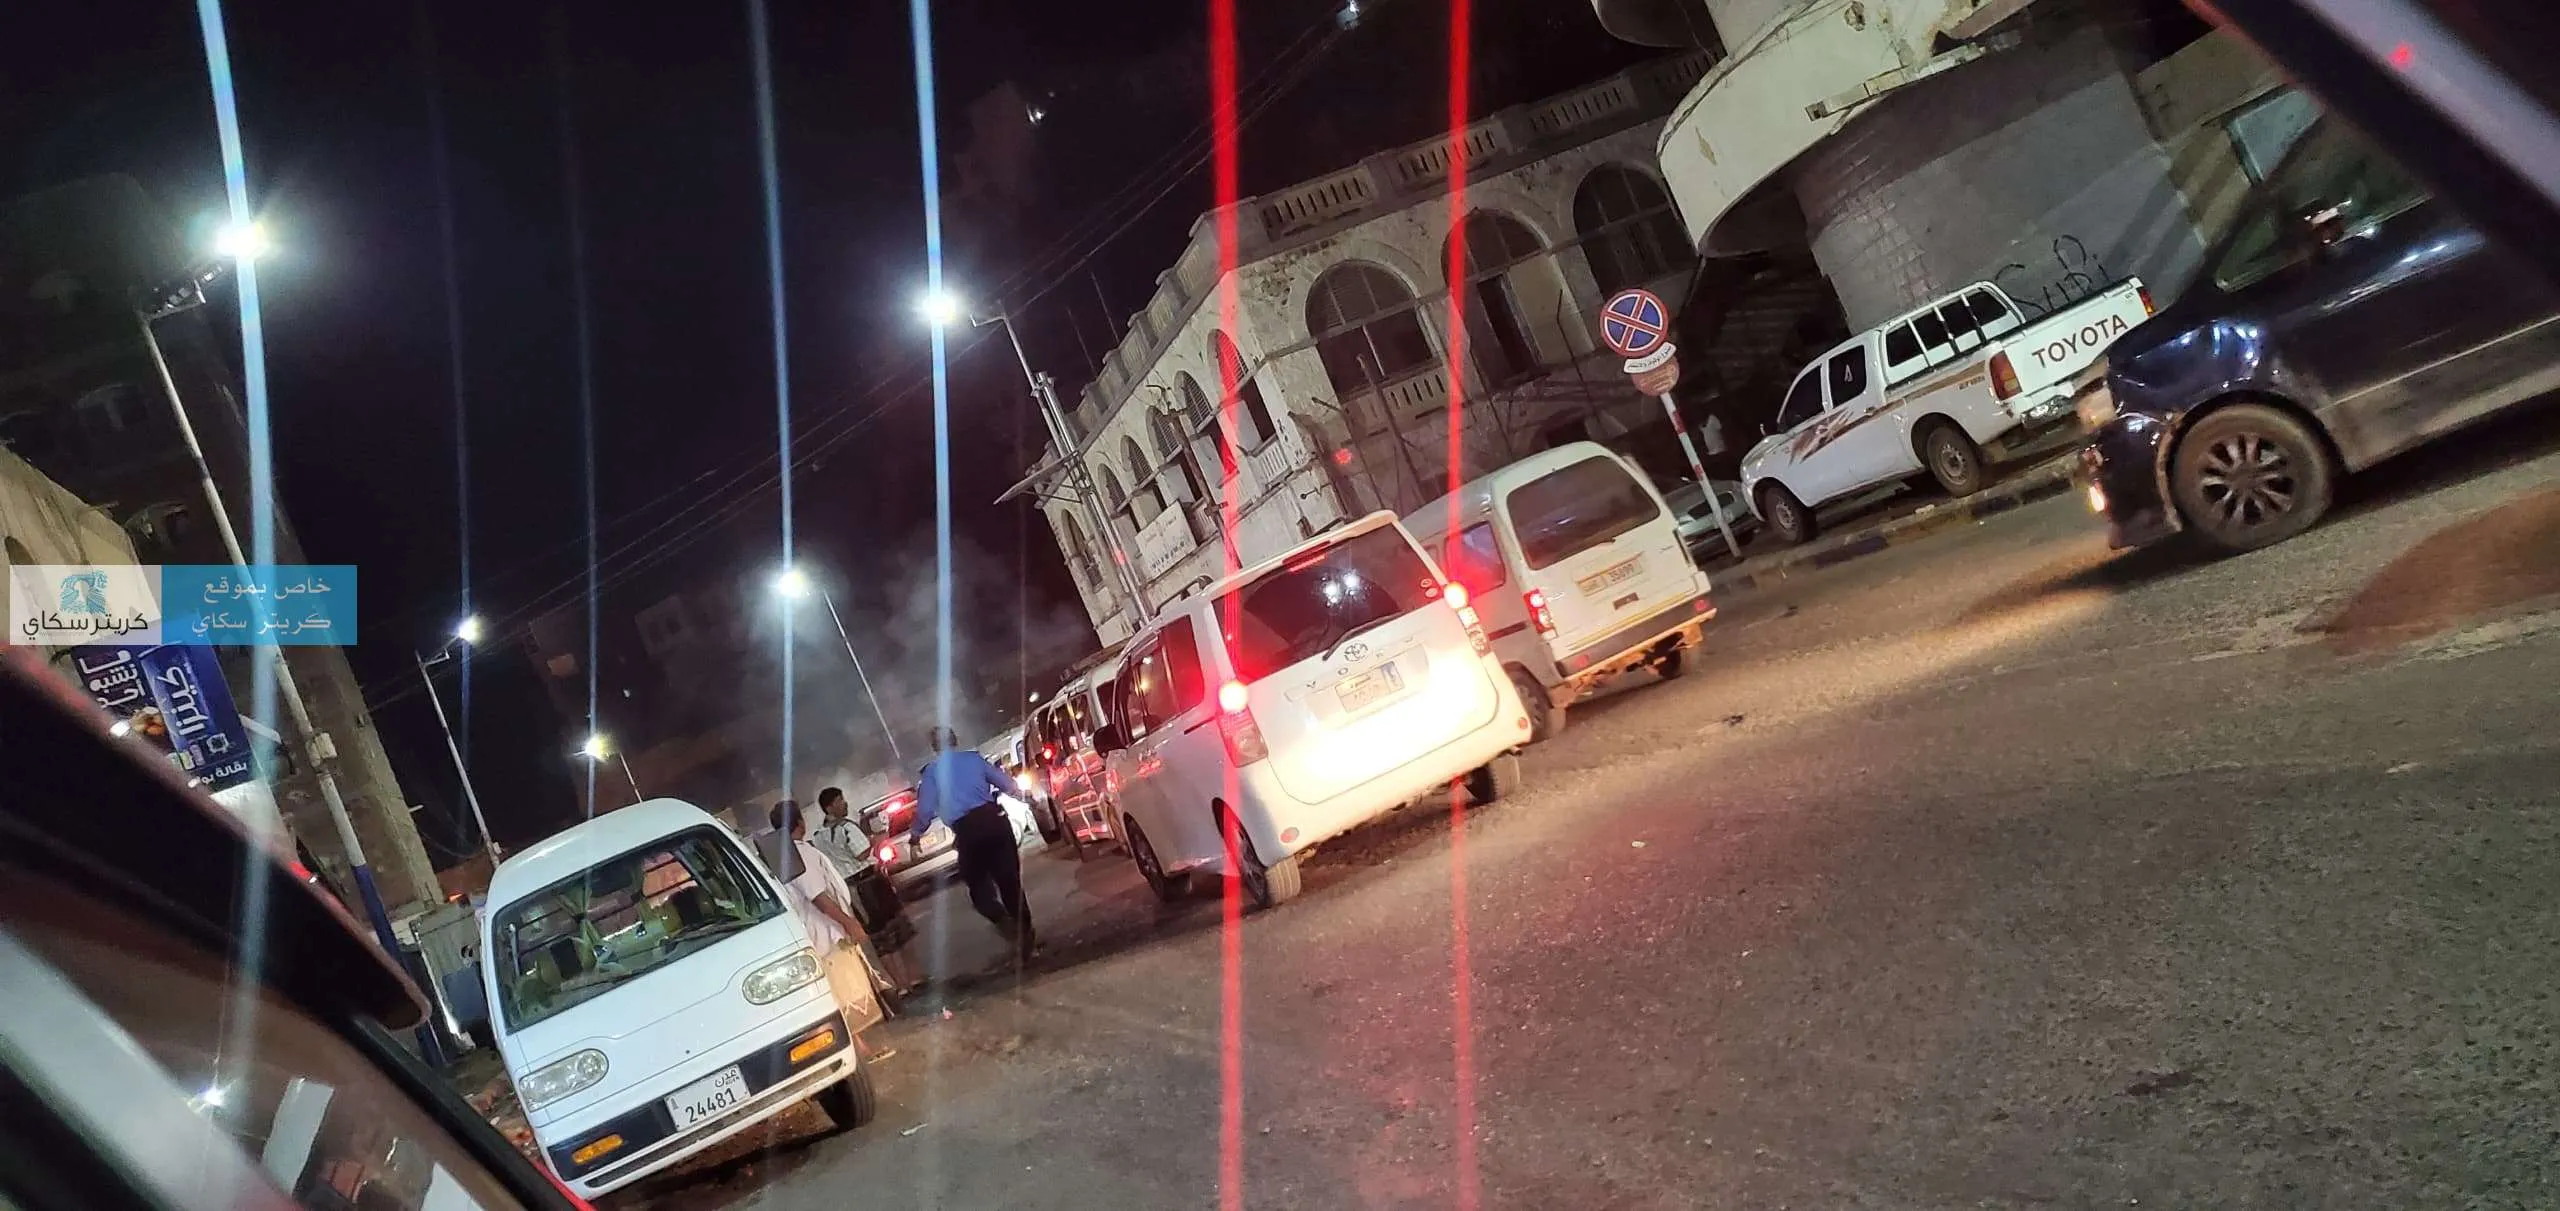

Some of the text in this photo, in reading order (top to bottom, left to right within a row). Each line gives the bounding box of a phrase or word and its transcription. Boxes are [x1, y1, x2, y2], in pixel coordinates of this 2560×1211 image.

[2032, 314, 2128, 368] TOYOTA
[79, 650, 131, 674] ما
[216, 762, 247, 778] بقالة
[714, 1069, 737, 1088] عدن
[685, 1088, 737, 1123] 24481
